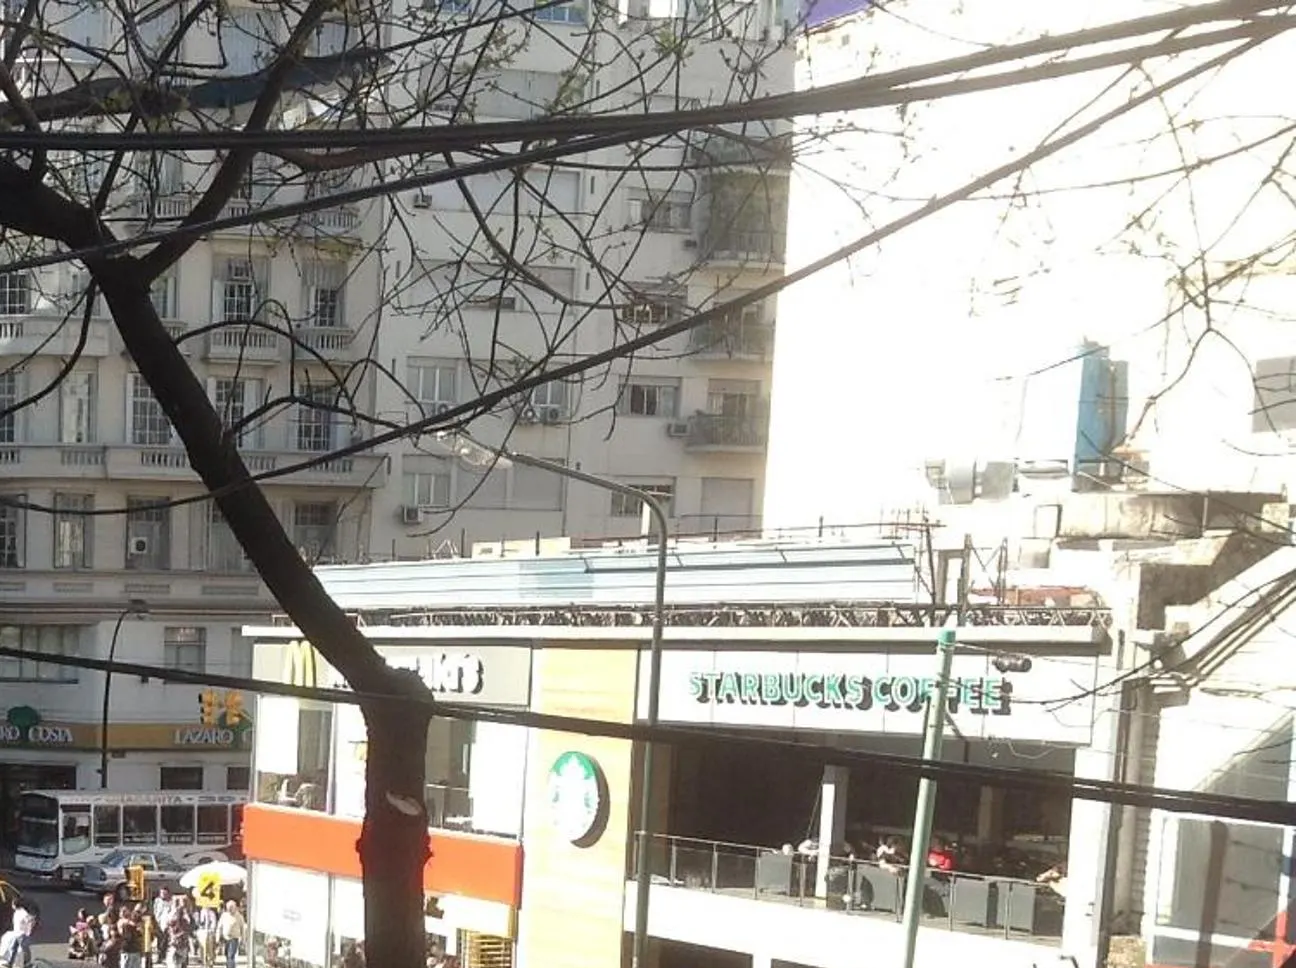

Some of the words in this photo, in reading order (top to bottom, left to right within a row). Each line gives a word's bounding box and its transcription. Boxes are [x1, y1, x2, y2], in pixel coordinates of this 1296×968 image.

[688, 671, 864, 704] STARBUCKS
[27, 724, 74, 742] COSTA
[173, 728, 234, 745] LAZARO
